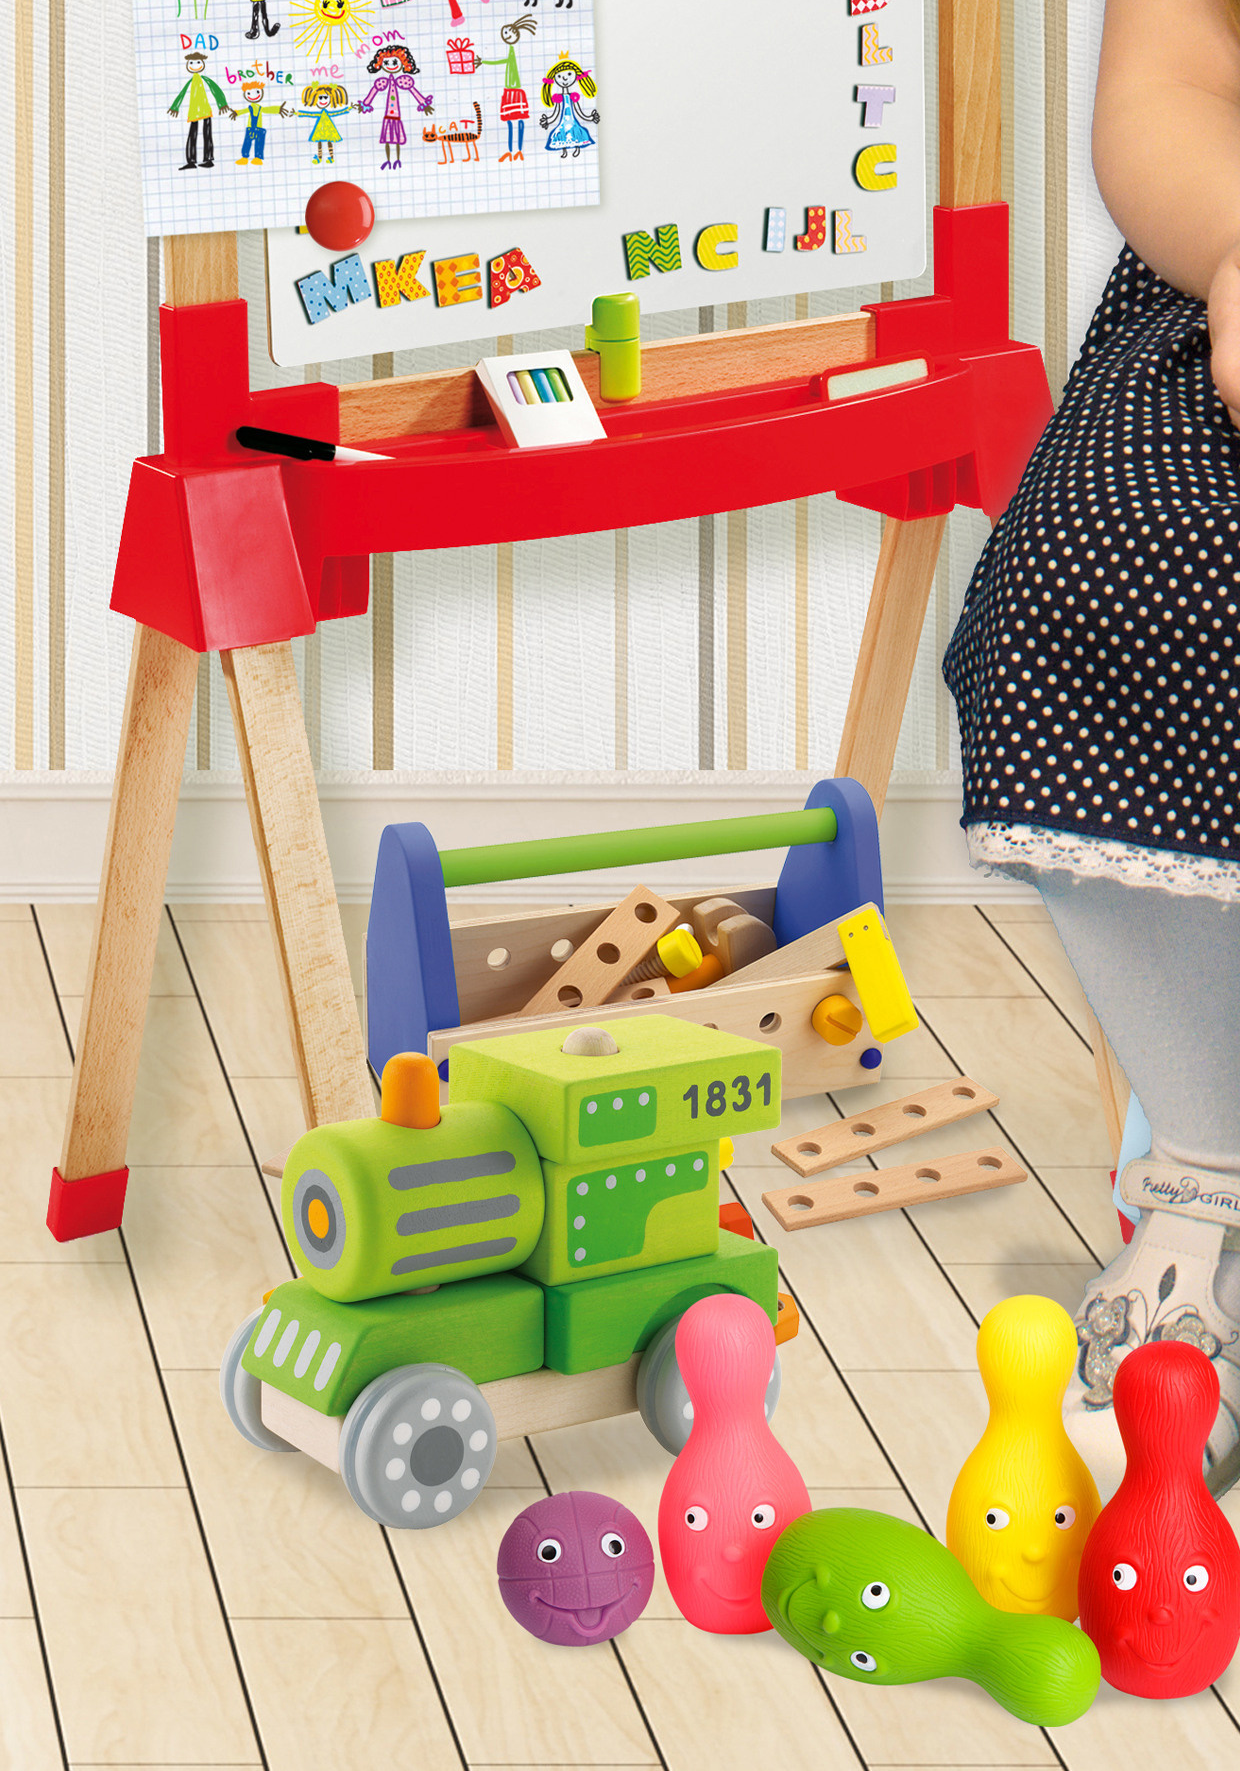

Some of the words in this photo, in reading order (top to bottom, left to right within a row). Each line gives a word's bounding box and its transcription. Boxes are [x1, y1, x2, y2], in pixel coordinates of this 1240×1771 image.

[180, 33, 219, 51] DAD
[310, 64, 344, 79] me
[683, 1072, 771, 1119] 1831
